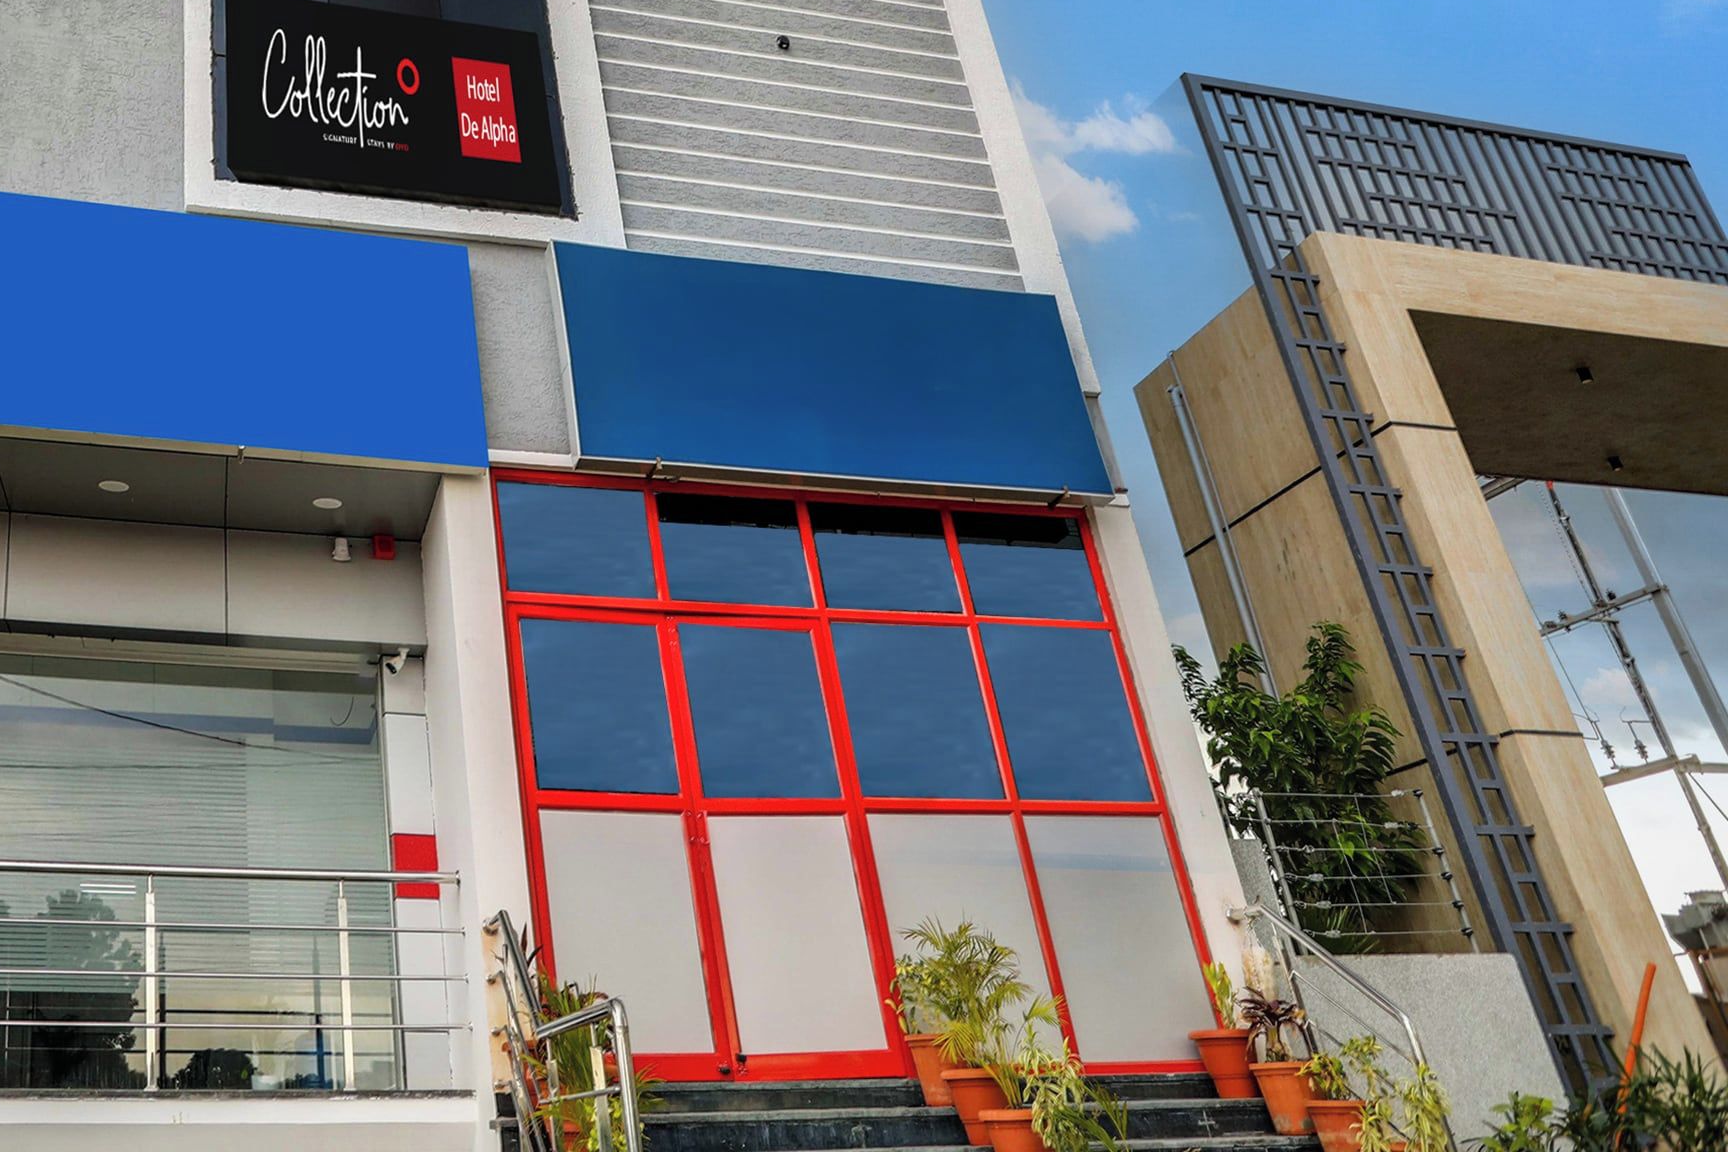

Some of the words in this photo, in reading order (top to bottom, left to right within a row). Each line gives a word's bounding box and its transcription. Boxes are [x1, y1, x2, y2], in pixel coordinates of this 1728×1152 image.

[262, 28, 409, 148] Collection
[467, 75, 501, 102] Hotel
[461, 112, 479, 140] De
[481, 115, 516, 147] Alpha
